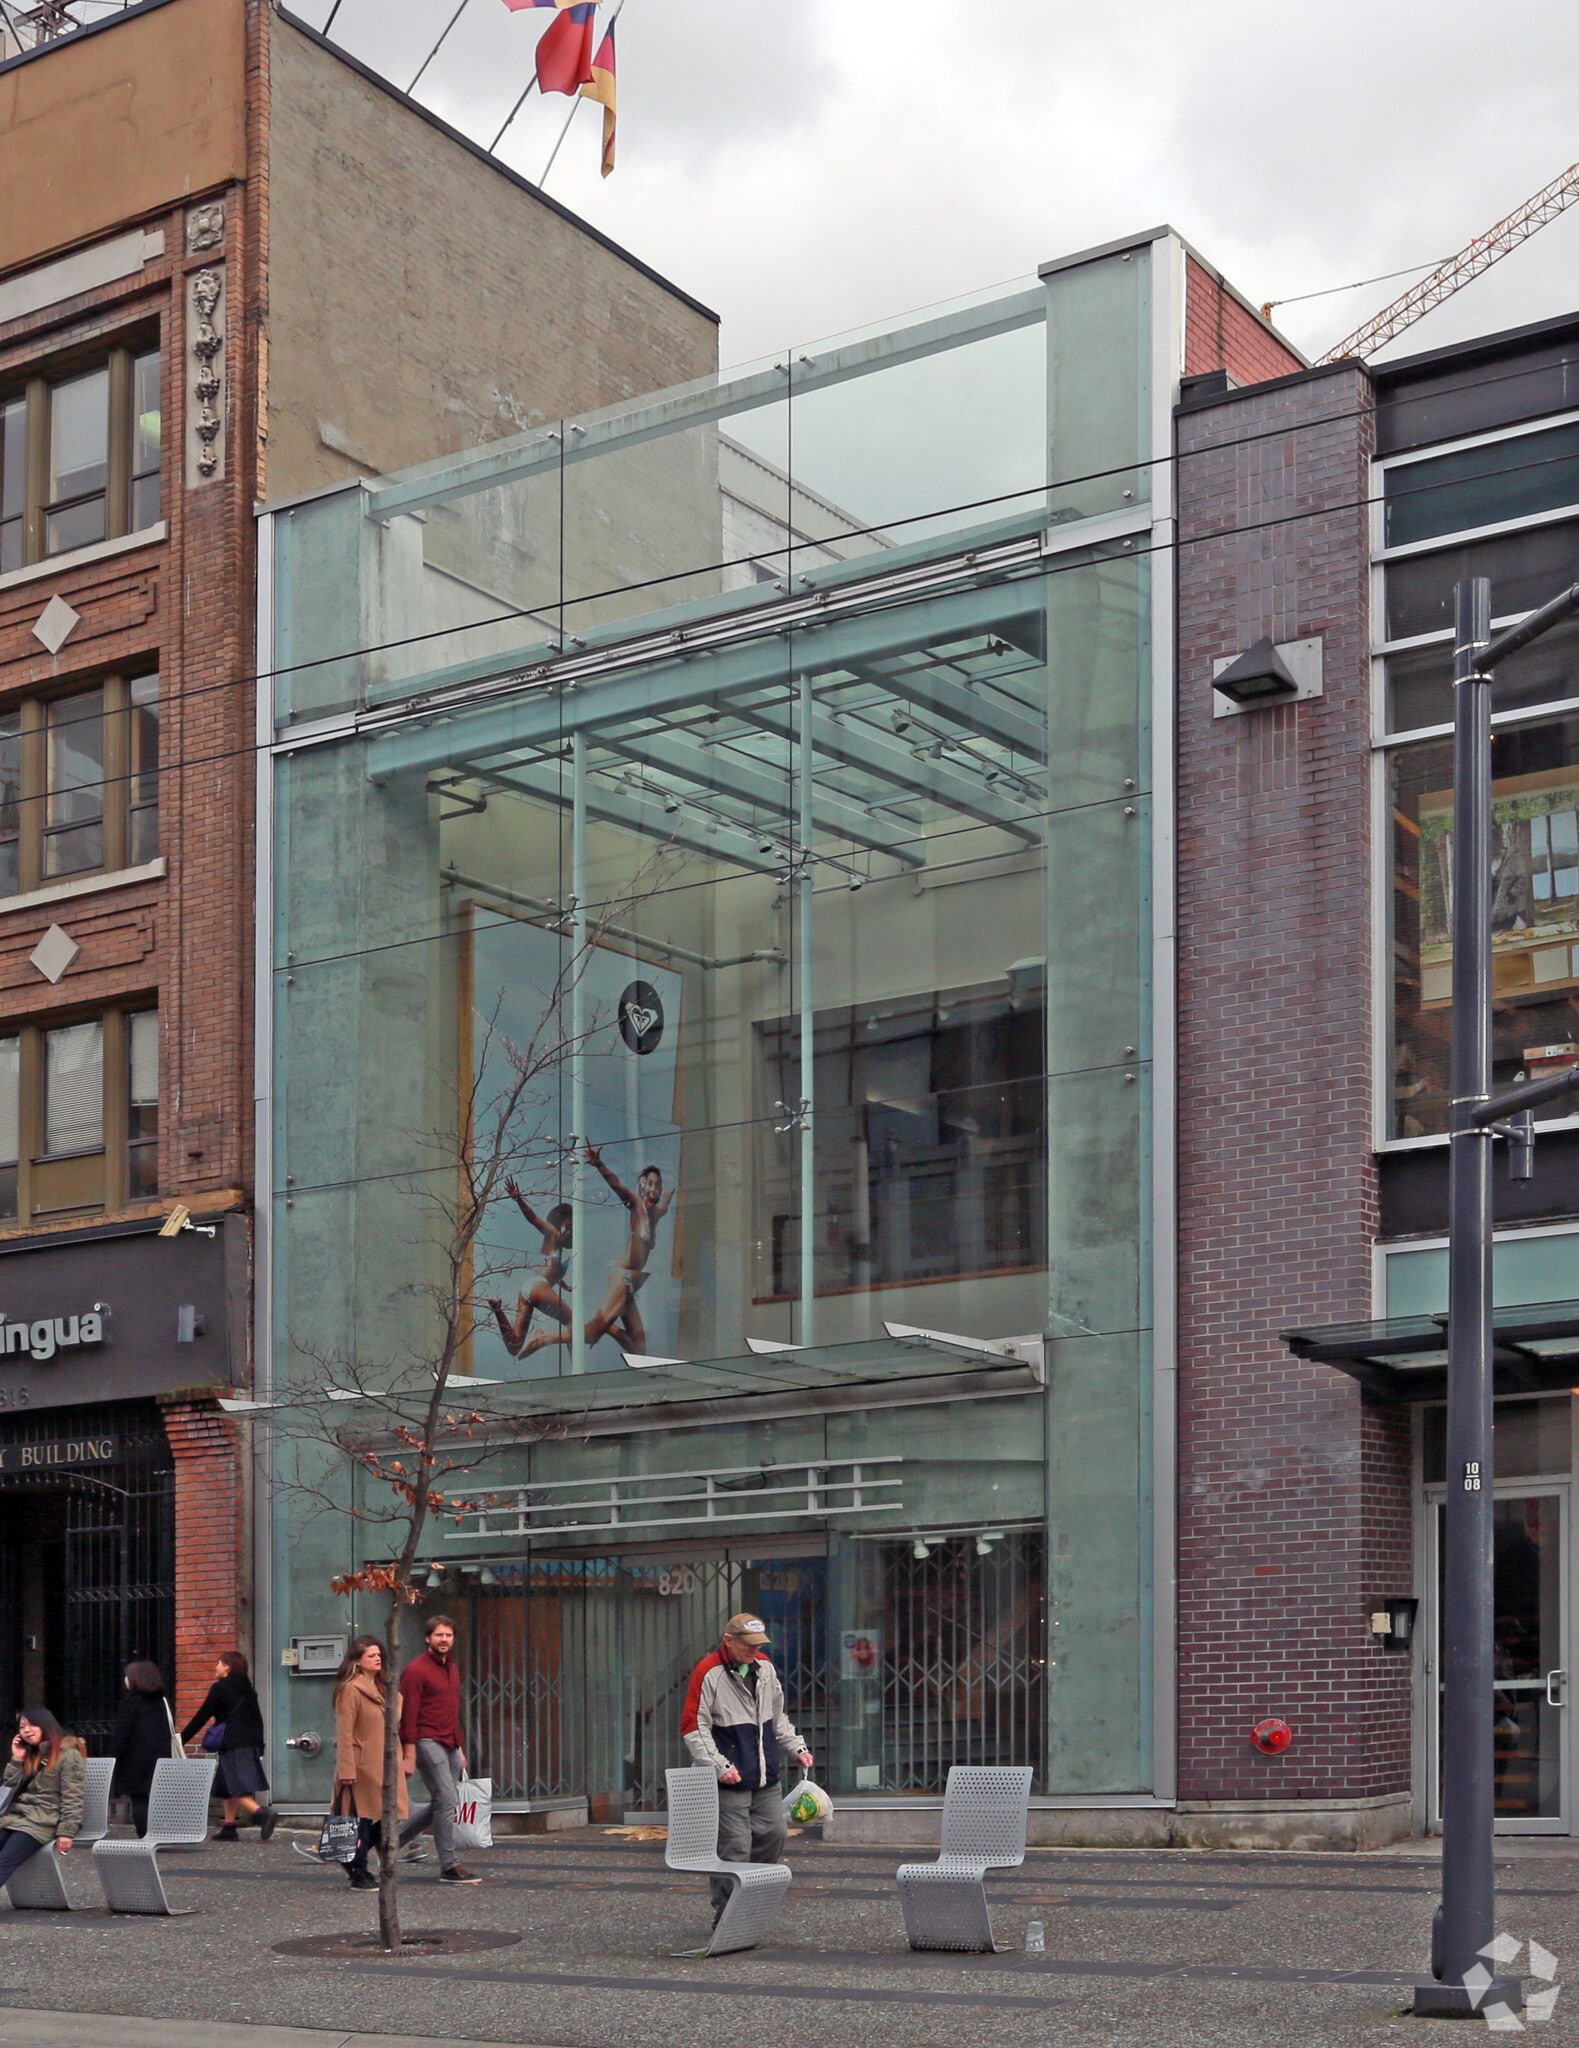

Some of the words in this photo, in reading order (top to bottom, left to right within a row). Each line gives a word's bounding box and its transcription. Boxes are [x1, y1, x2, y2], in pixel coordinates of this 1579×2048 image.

[21, 1440, 113, 1467] BUILDING
[1465, 1462, 1479, 1474] 10
[1464, 1479, 1480, 1490] 08
[658, 1568, 695, 1596] 820
